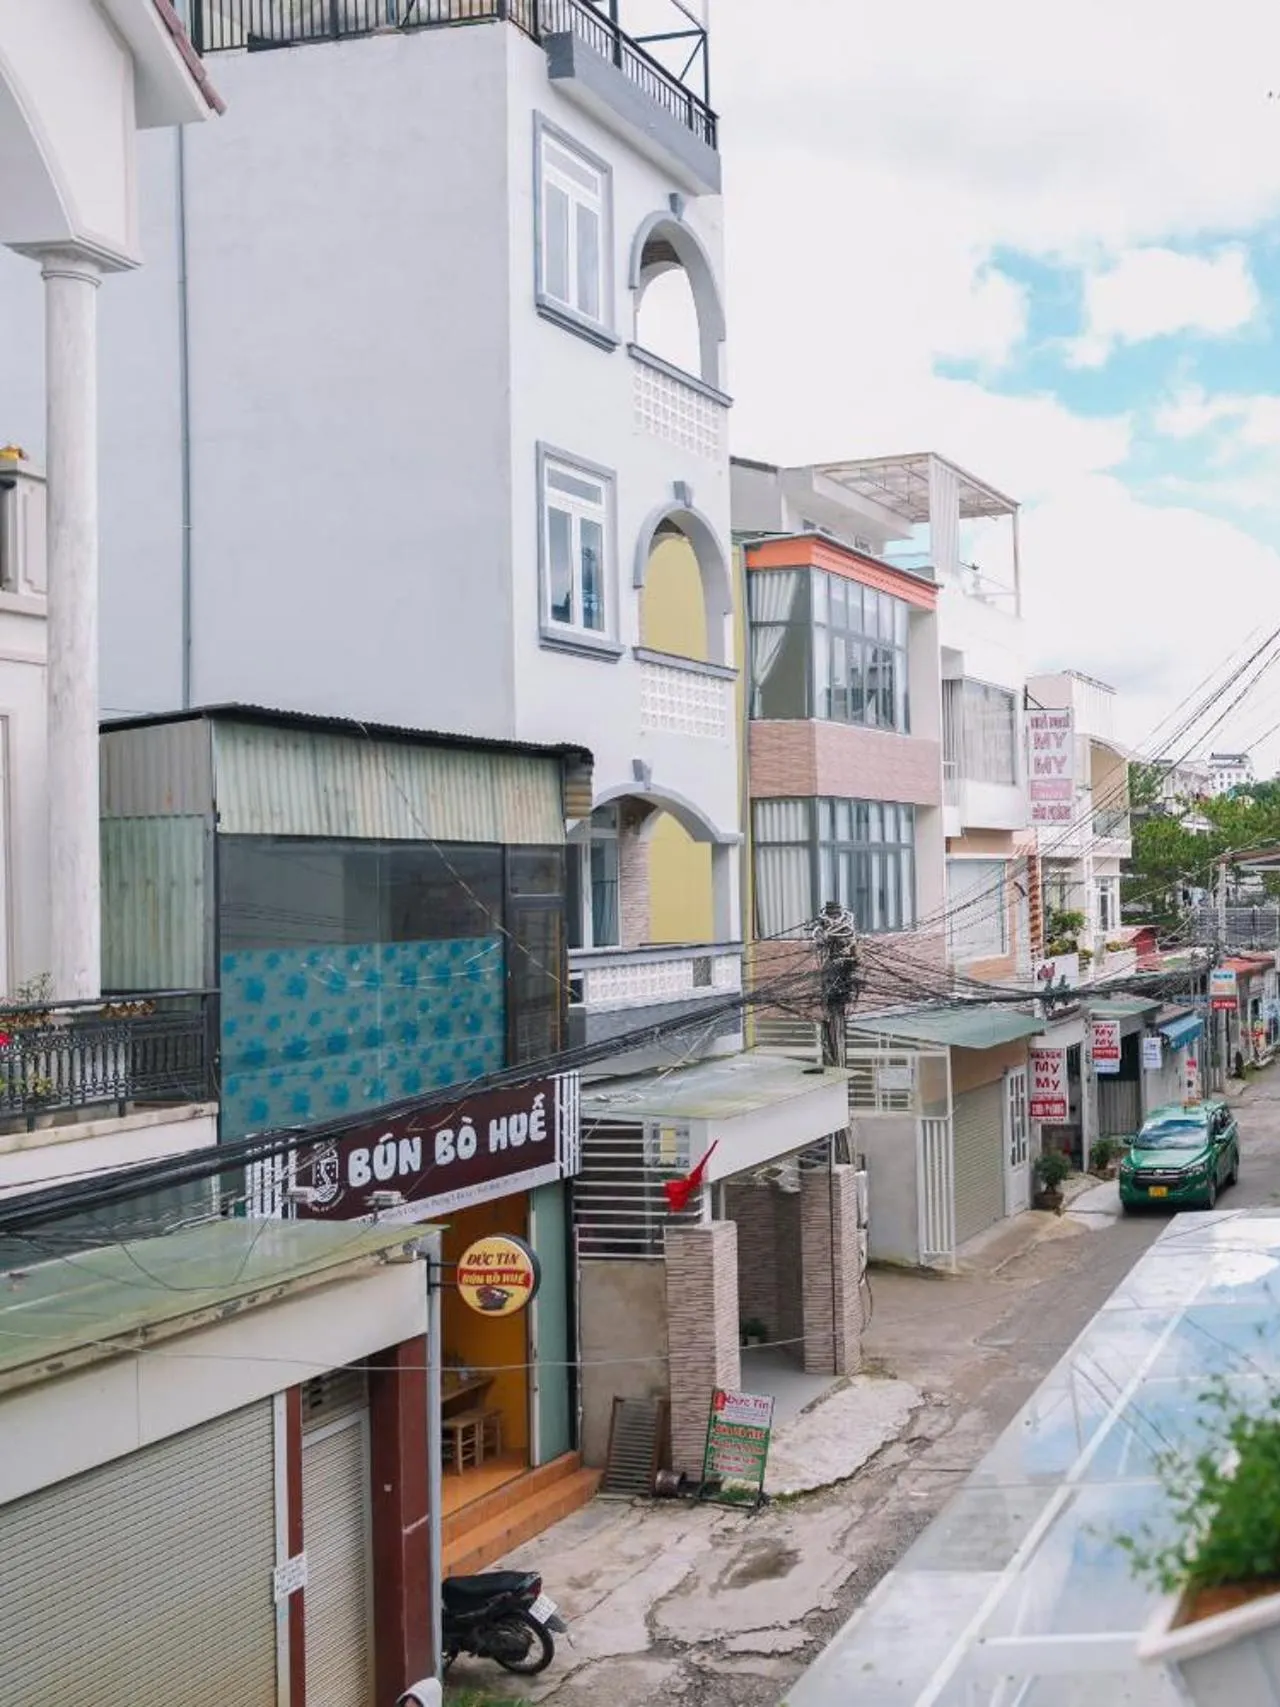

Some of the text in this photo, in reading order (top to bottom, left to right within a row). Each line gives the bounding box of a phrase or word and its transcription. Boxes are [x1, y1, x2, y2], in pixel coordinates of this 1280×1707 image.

[1034, 732, 1067, 749] MY
[1034, 756, 1067, 774] MY
[1035, 1061, 1060, 1074] My
[1036, 1077, 1060, 1091] My
[349, 1133, 421, 1187] BÚN
[435, 1116, 477, 1165] BÒ
[489, 1092, 547, 1152] HUẾ
